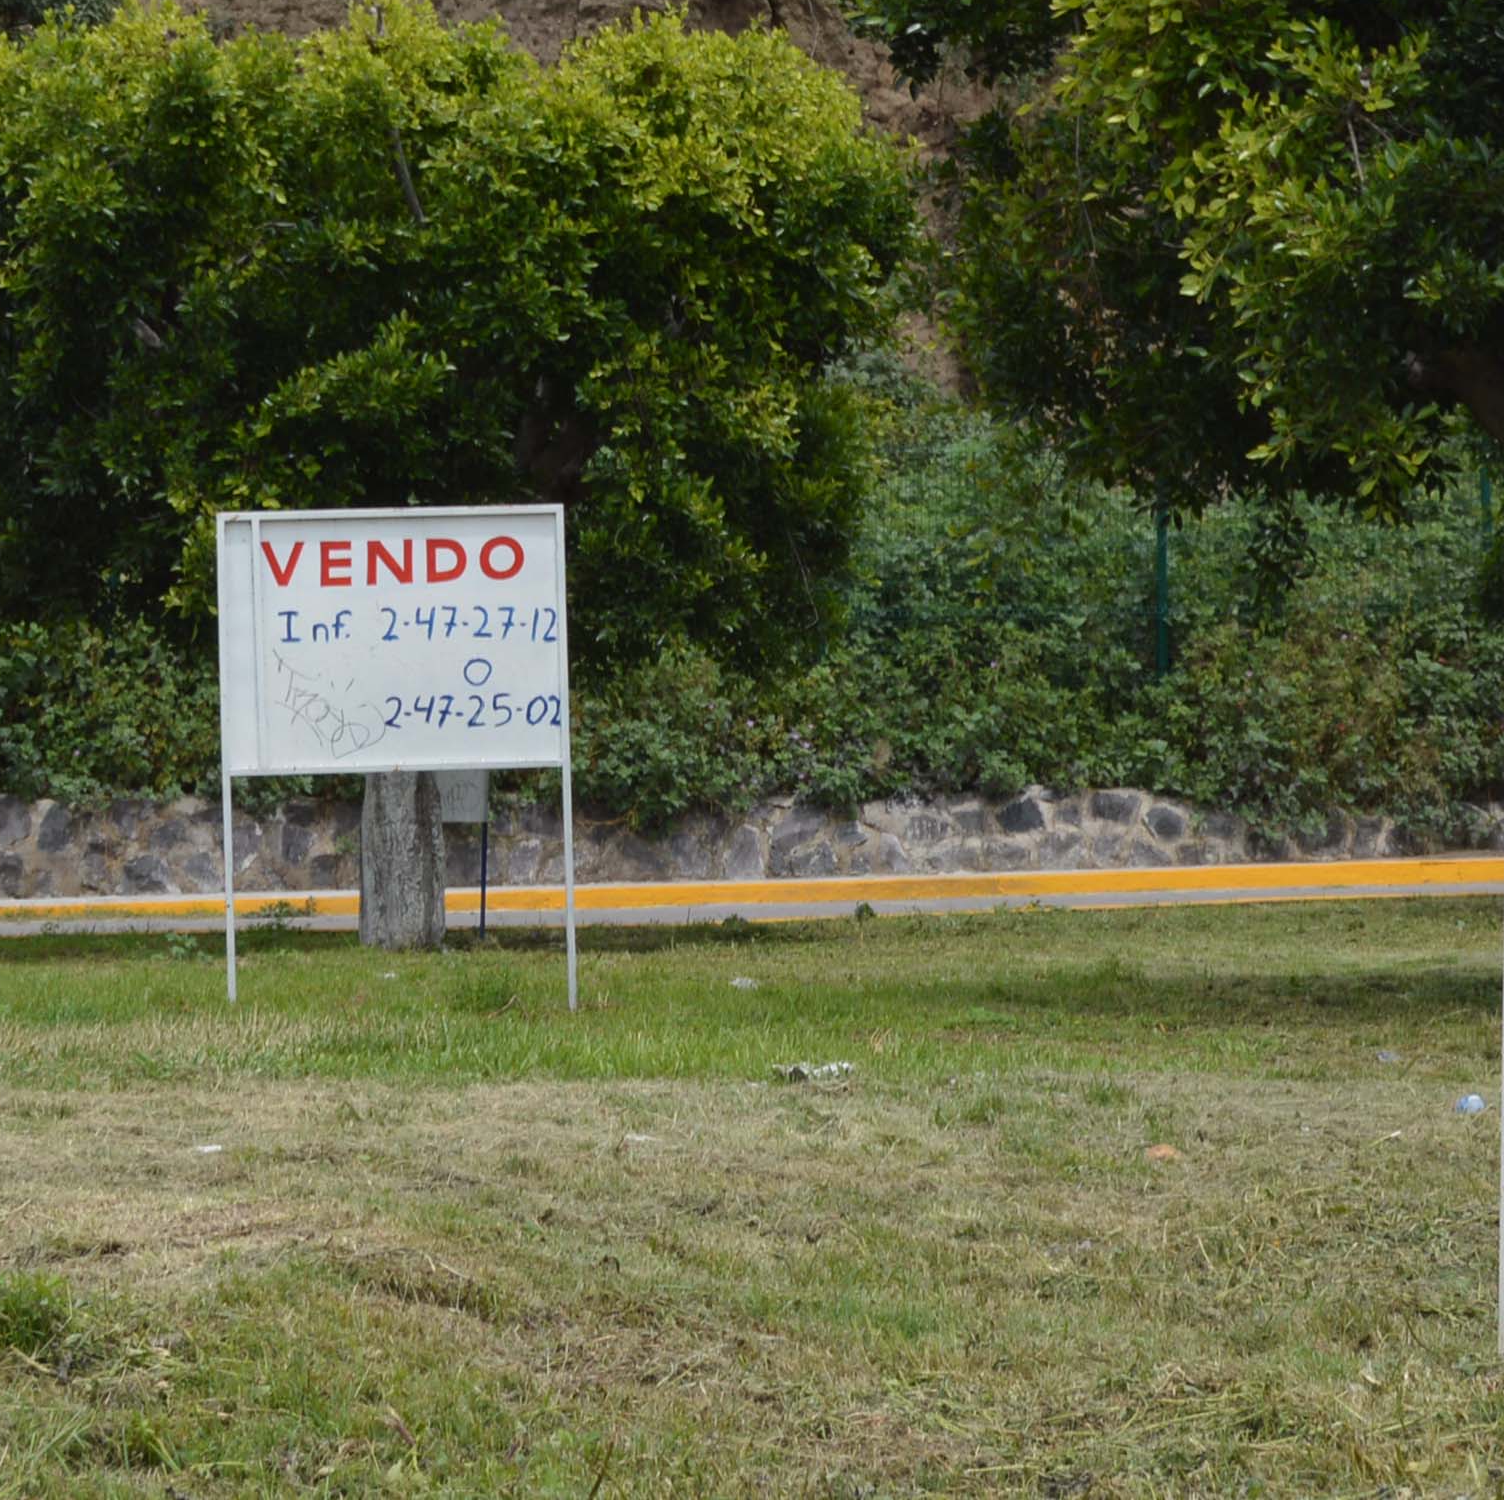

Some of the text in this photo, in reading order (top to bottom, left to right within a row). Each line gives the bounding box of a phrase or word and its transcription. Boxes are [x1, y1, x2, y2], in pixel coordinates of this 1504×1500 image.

[261, 536, 525, 587] VENDO
[278, 606, 557, 643] Inf. 2-47-27-12
[384, 693, 561, 728] 2-47-25-02
